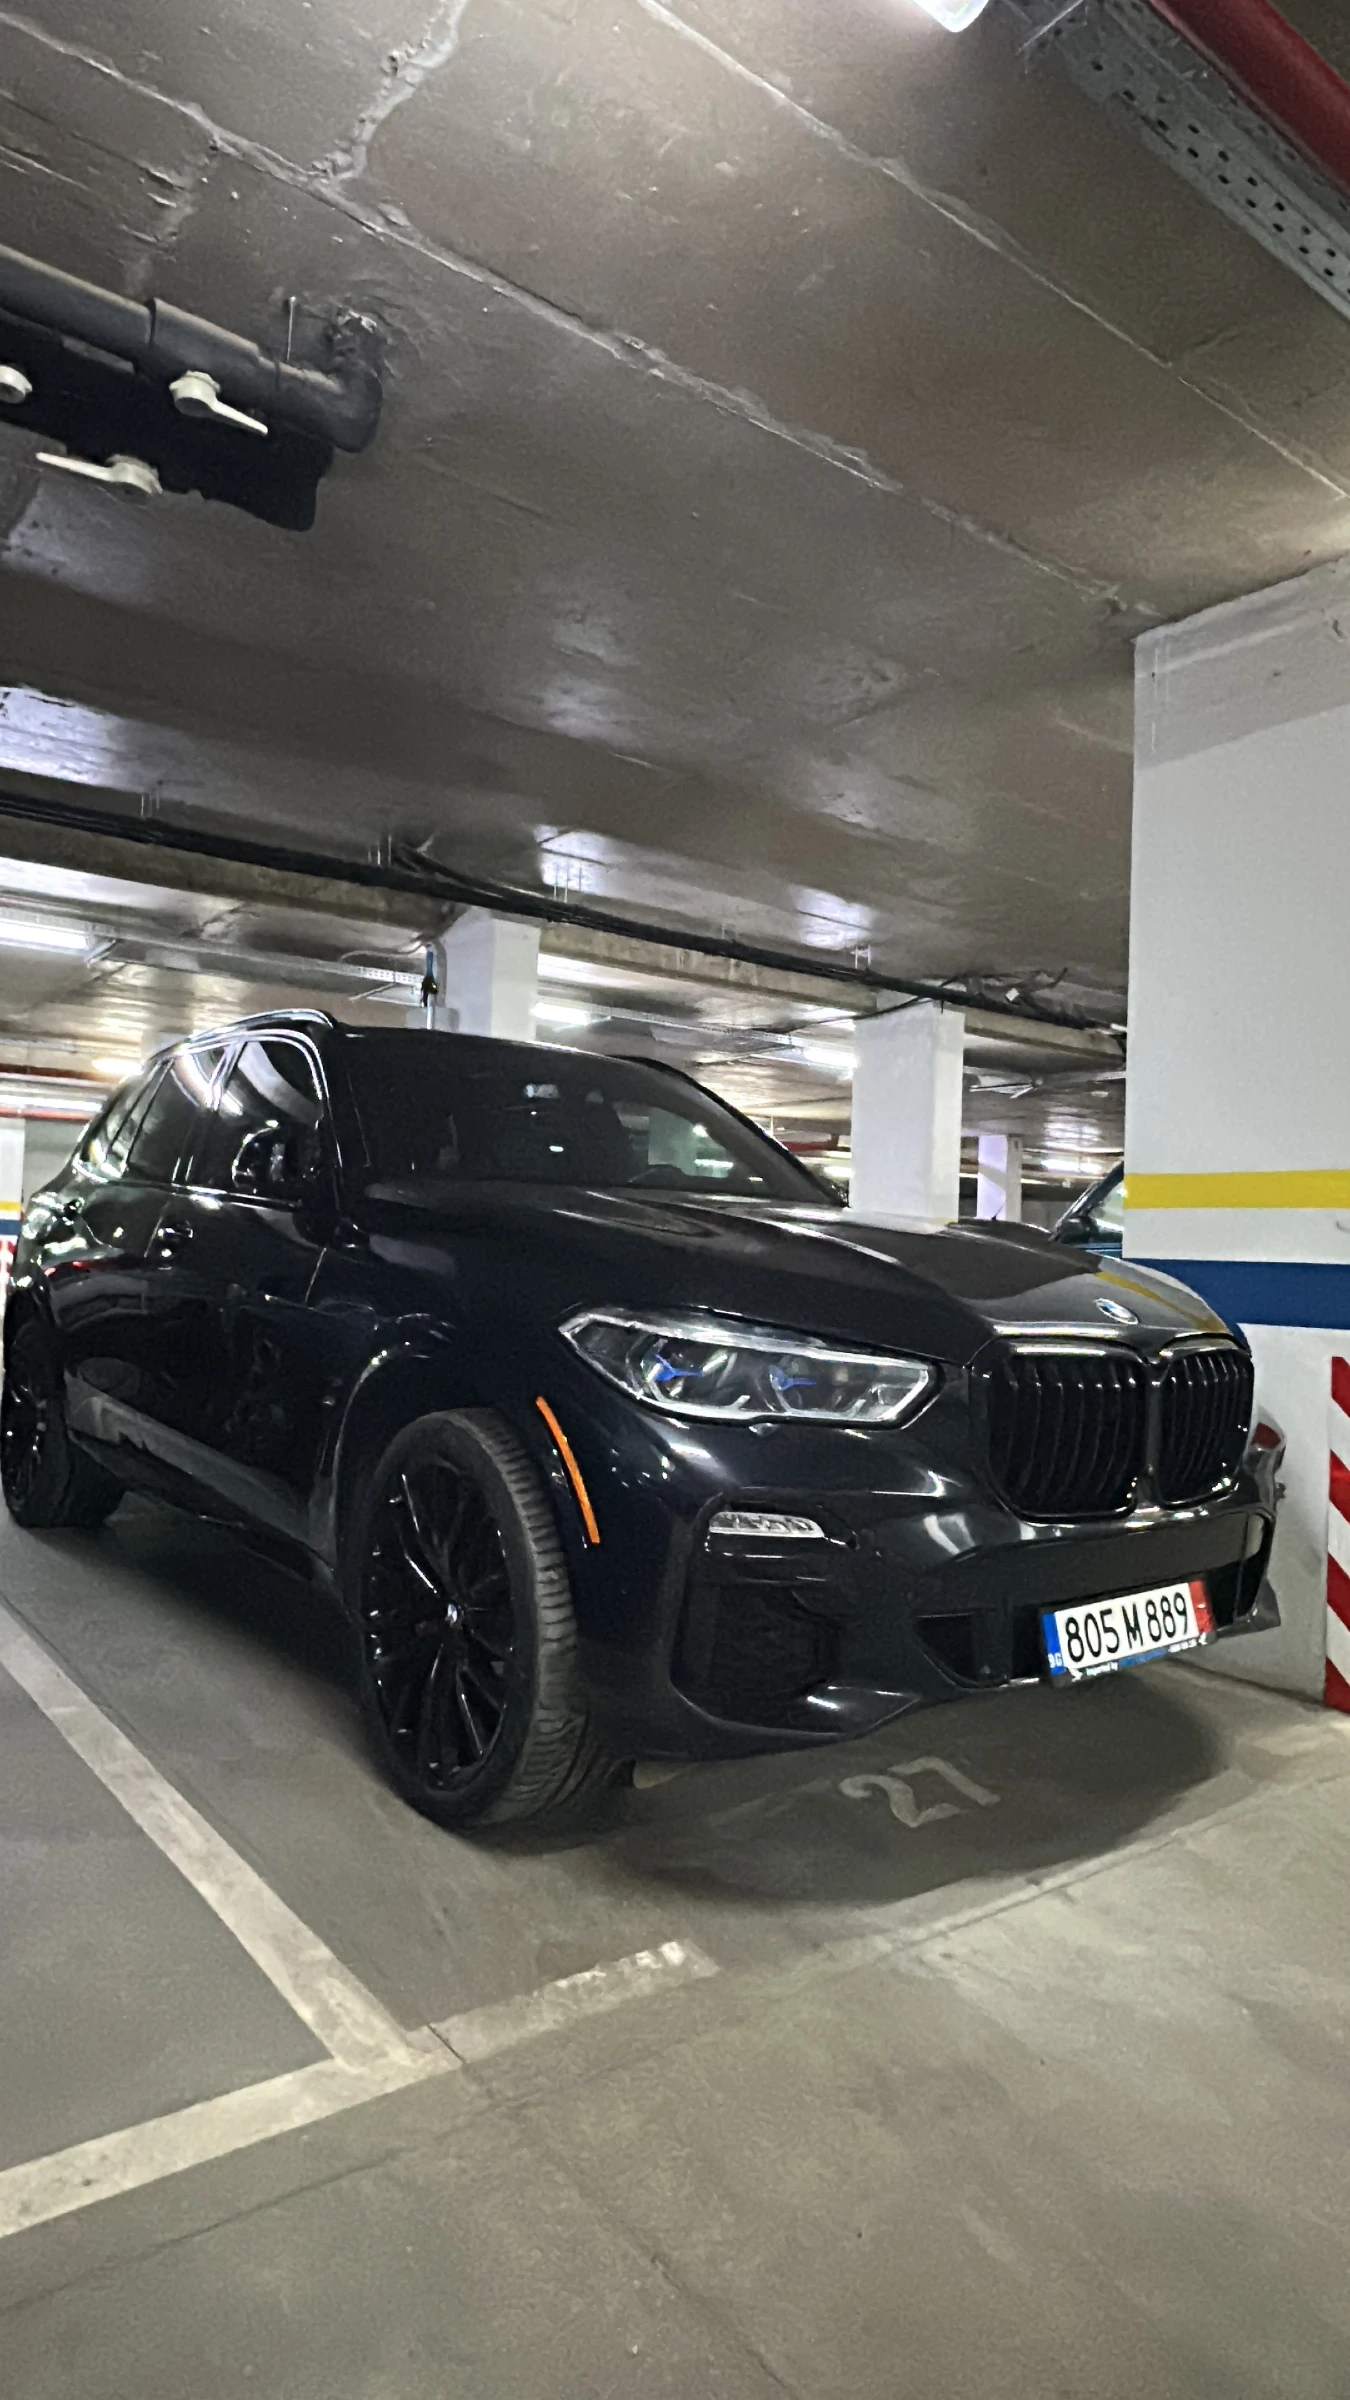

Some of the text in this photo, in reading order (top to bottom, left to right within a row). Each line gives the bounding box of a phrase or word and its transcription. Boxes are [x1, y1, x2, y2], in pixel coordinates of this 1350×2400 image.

[1065, 1608, 1120, 1662] 805
[1121, 1602, 1144, 1650] M
[1145, 1592, 1188, 1642] 889
